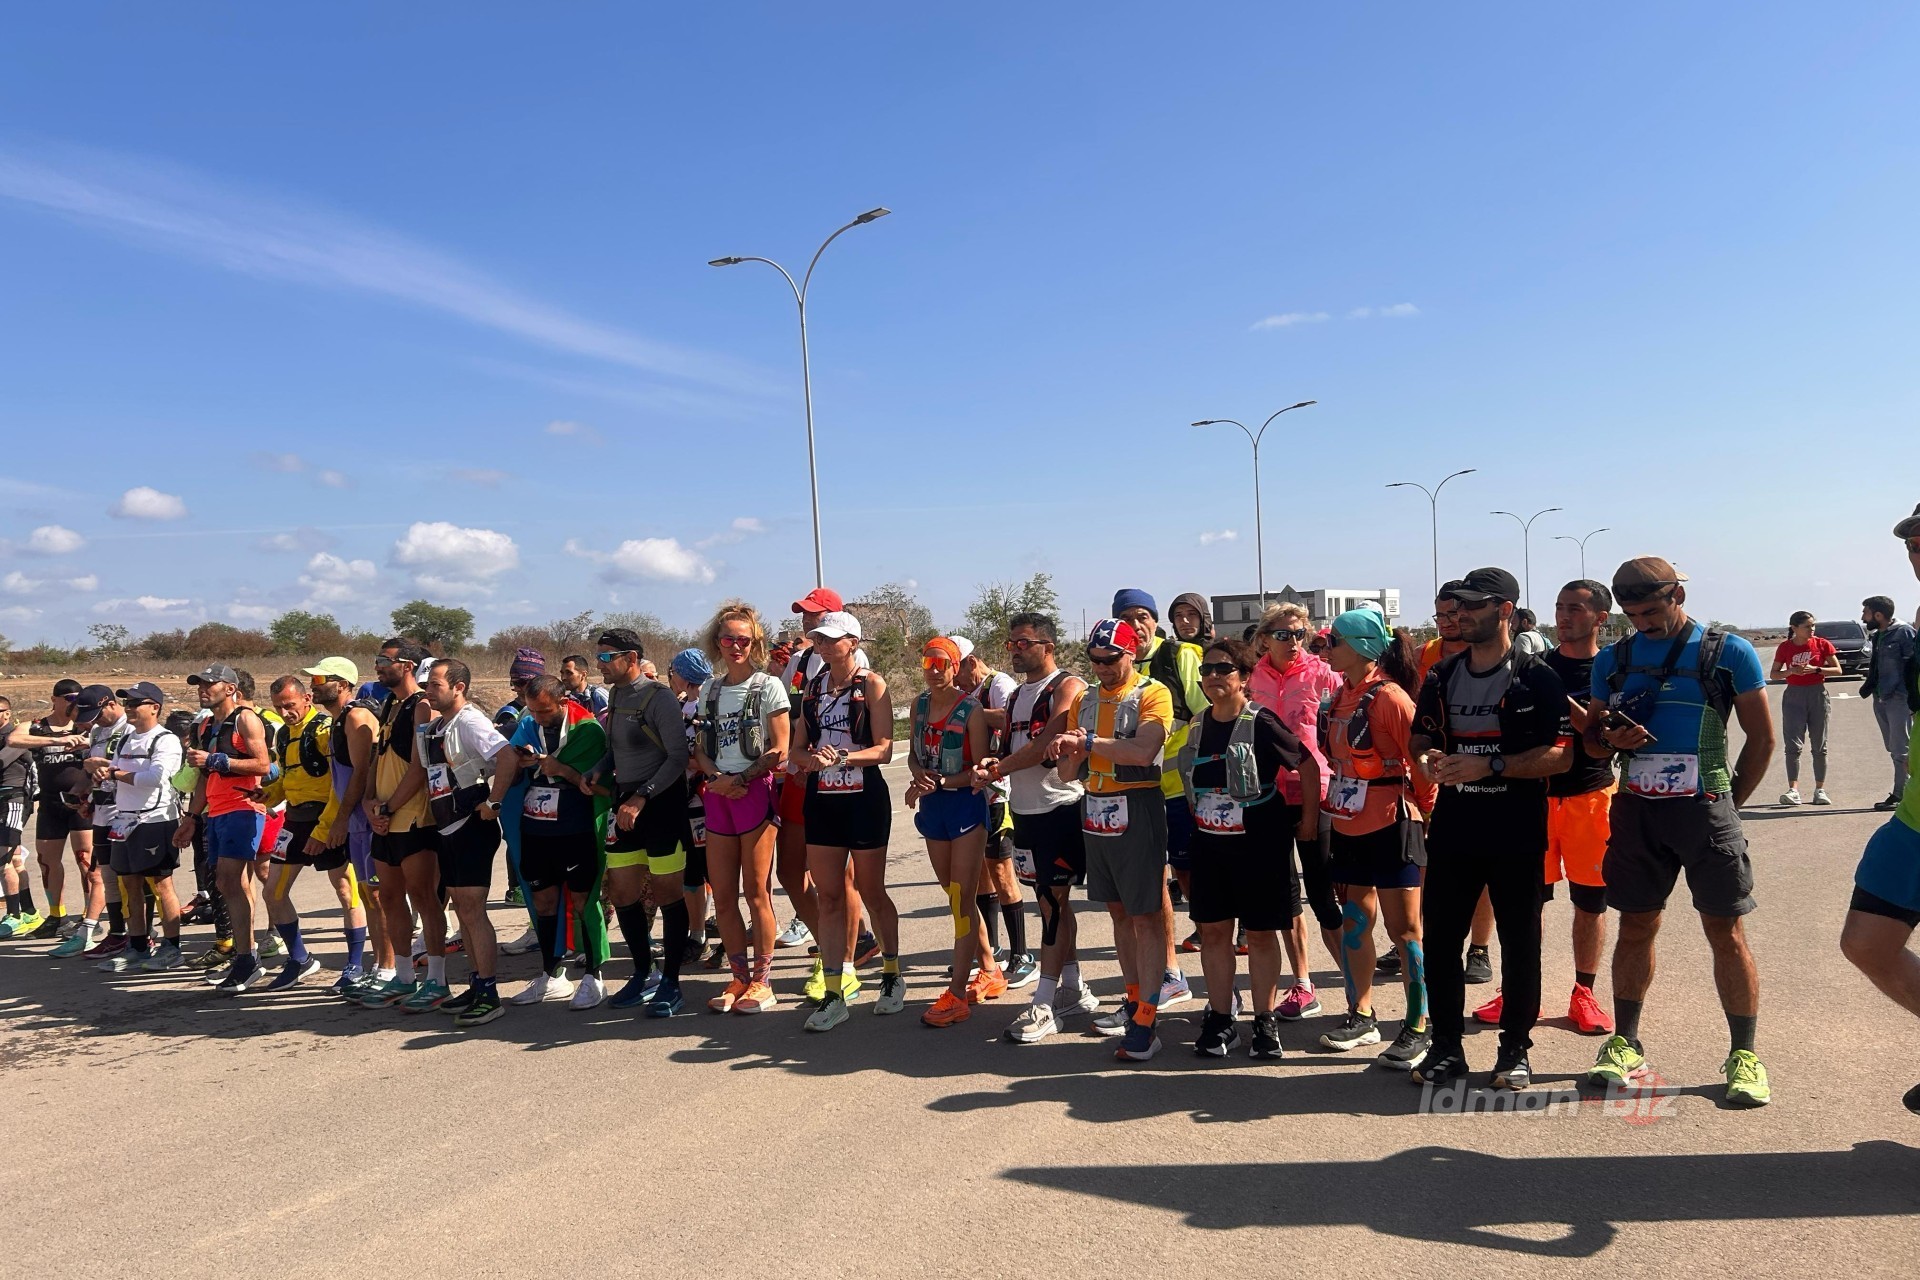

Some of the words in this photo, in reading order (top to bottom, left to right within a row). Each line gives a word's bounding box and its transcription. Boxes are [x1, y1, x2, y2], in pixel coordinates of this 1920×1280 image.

[1640, 772, 1685, 793] 052
[1092, 812, 1120, 830] 018
[1202, 808, 1234, 828] 063
